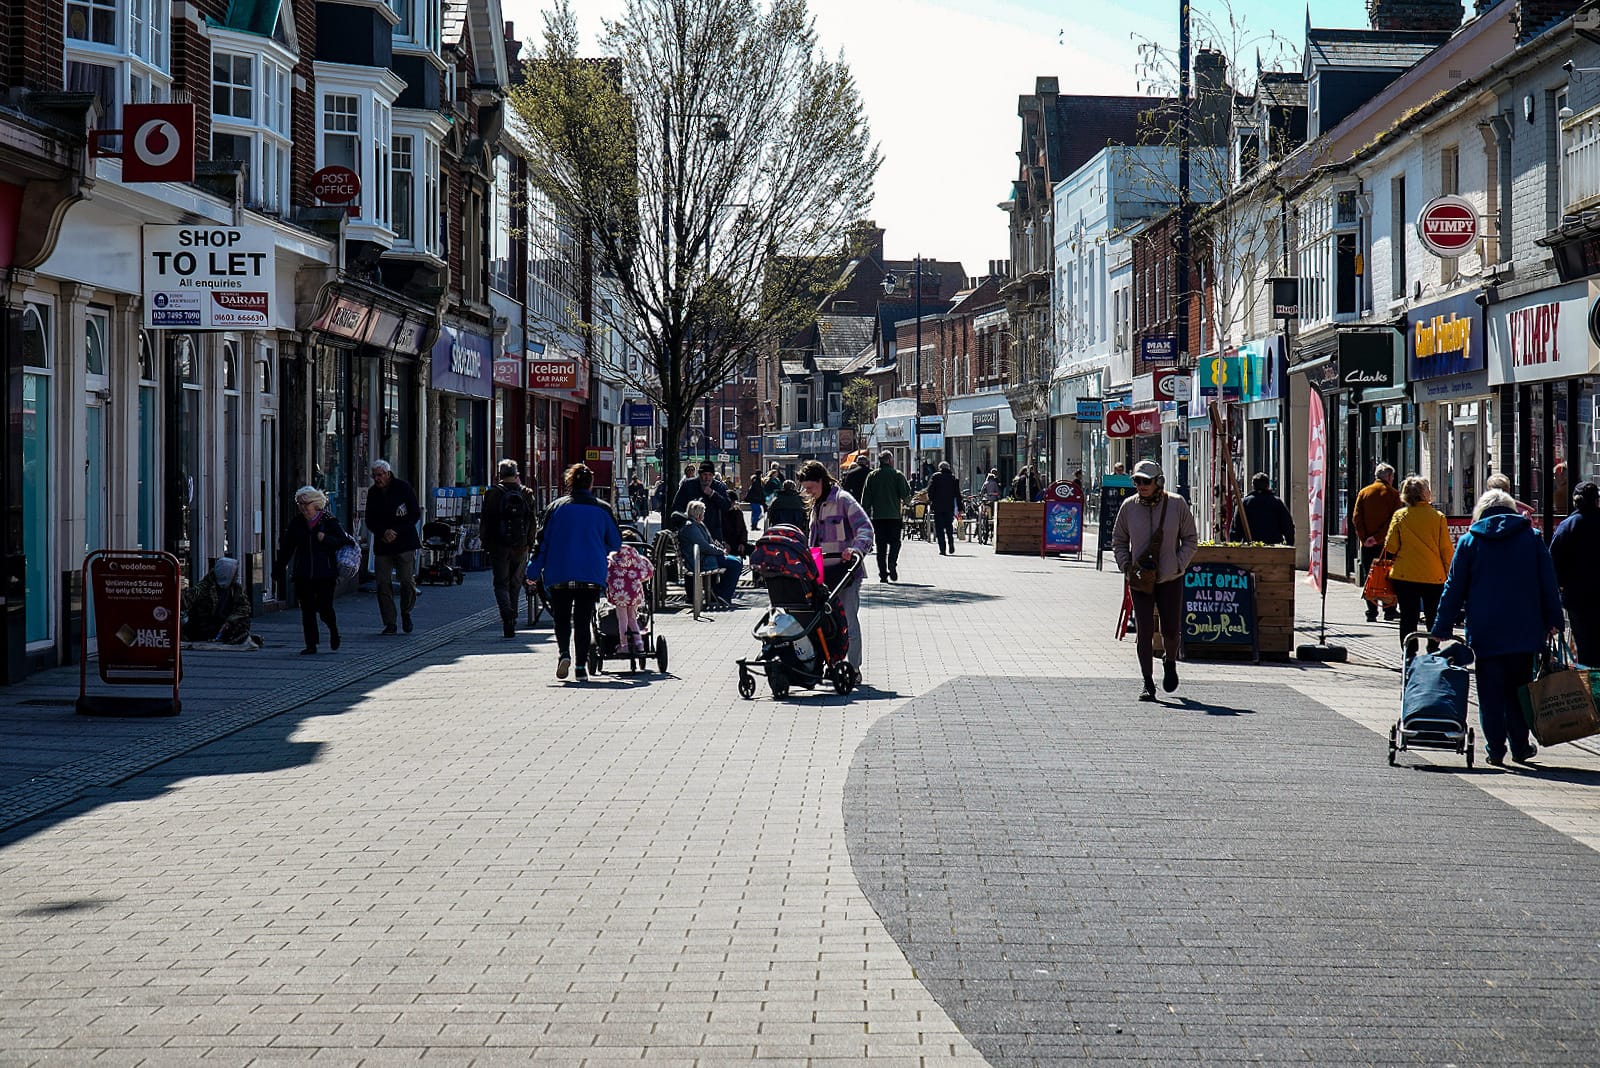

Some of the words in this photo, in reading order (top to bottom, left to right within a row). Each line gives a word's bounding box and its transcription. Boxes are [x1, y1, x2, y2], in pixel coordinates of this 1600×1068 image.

[322, 174, 350, 184] POST
[315, 185, 354, 195] OFFICE
[1426, 220, 1474, 232] WIMPY
[179, 230, 241, 247] SHOP
[153, 252, 197, 275] TO
[209, 253, 266, 276] LET
[179, 278, 192, 288] All
[195, 278, 242, 290] enquiries
[220, 296, 265, 305] DARRAH
[153, 311, 166, 320] 020
[184, 311, 200, 320] 7090
[1509, 302, 1560, 367] WIMPY
[1146, 341, 1171, 349] MAX
[530, 363, 575, 375] Iceland
[1344, 369, 1388, 382] Clarks
[105, 579, 138, 587] Unlimited
[1184, 572, 1213, 588] CAFE
[1215, 573, 1248, 589] OPEN
[115, 588, 130, 596] only
[1195, 590, 1213, 600] ALL
[1215, 590, 1236, 602] DAY
[1186, 601, 1240, 613] BREAKFAST
[136, 628, 168, 638] HALF
[137, 638, 171, 648] PRICE
